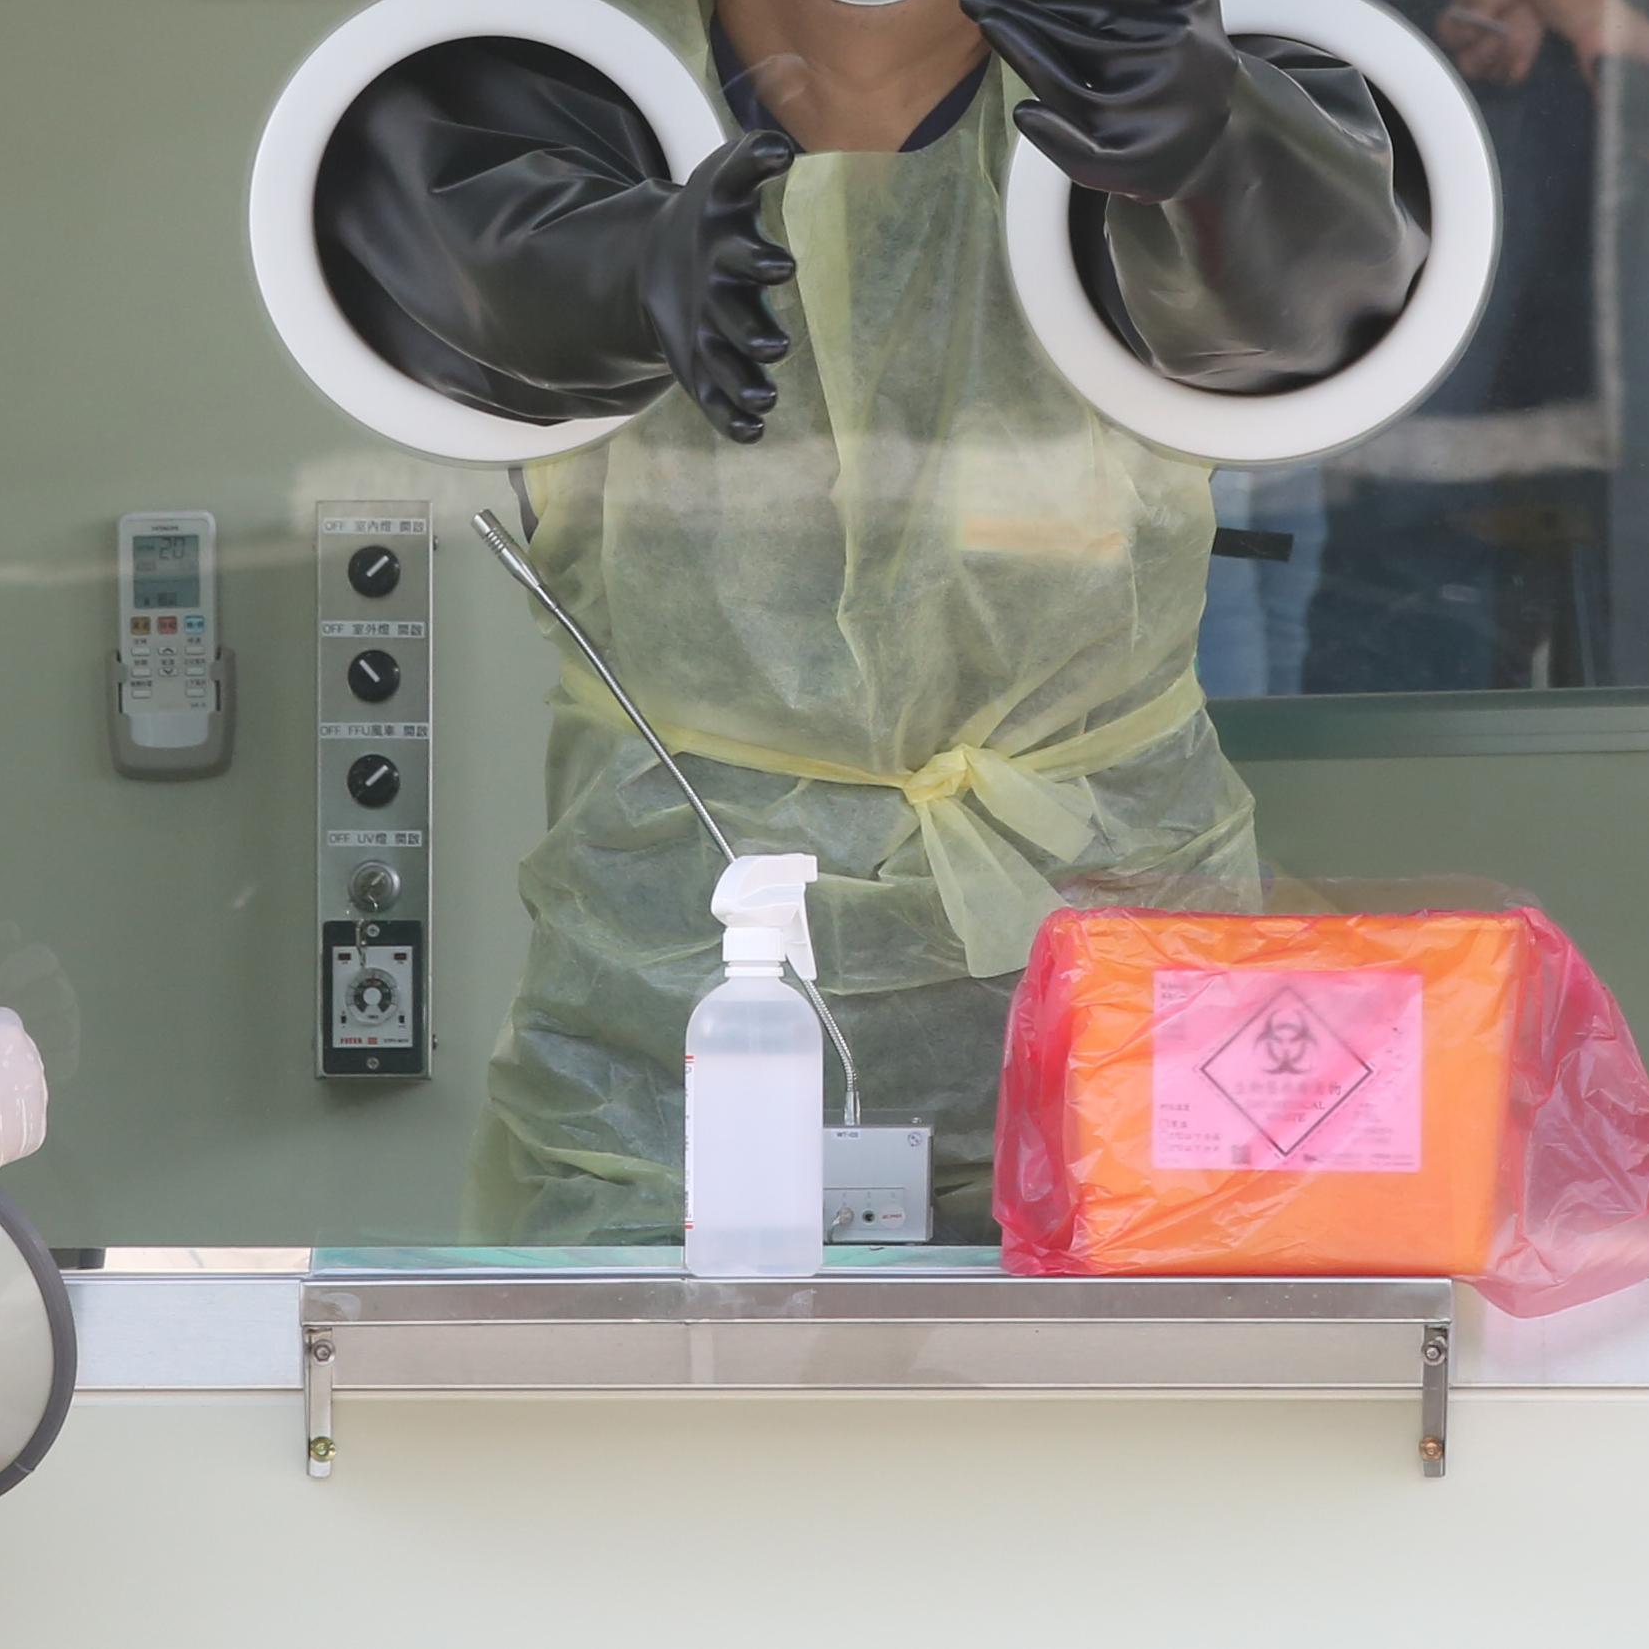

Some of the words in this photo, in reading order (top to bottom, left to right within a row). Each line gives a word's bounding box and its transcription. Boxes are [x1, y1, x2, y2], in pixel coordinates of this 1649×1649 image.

[324, 521, 344, 531] OFF
[322, 623, 344, 634] OFF
[320, 725, 341, 736] OFF
[329, 833, 350, 843] OFF
